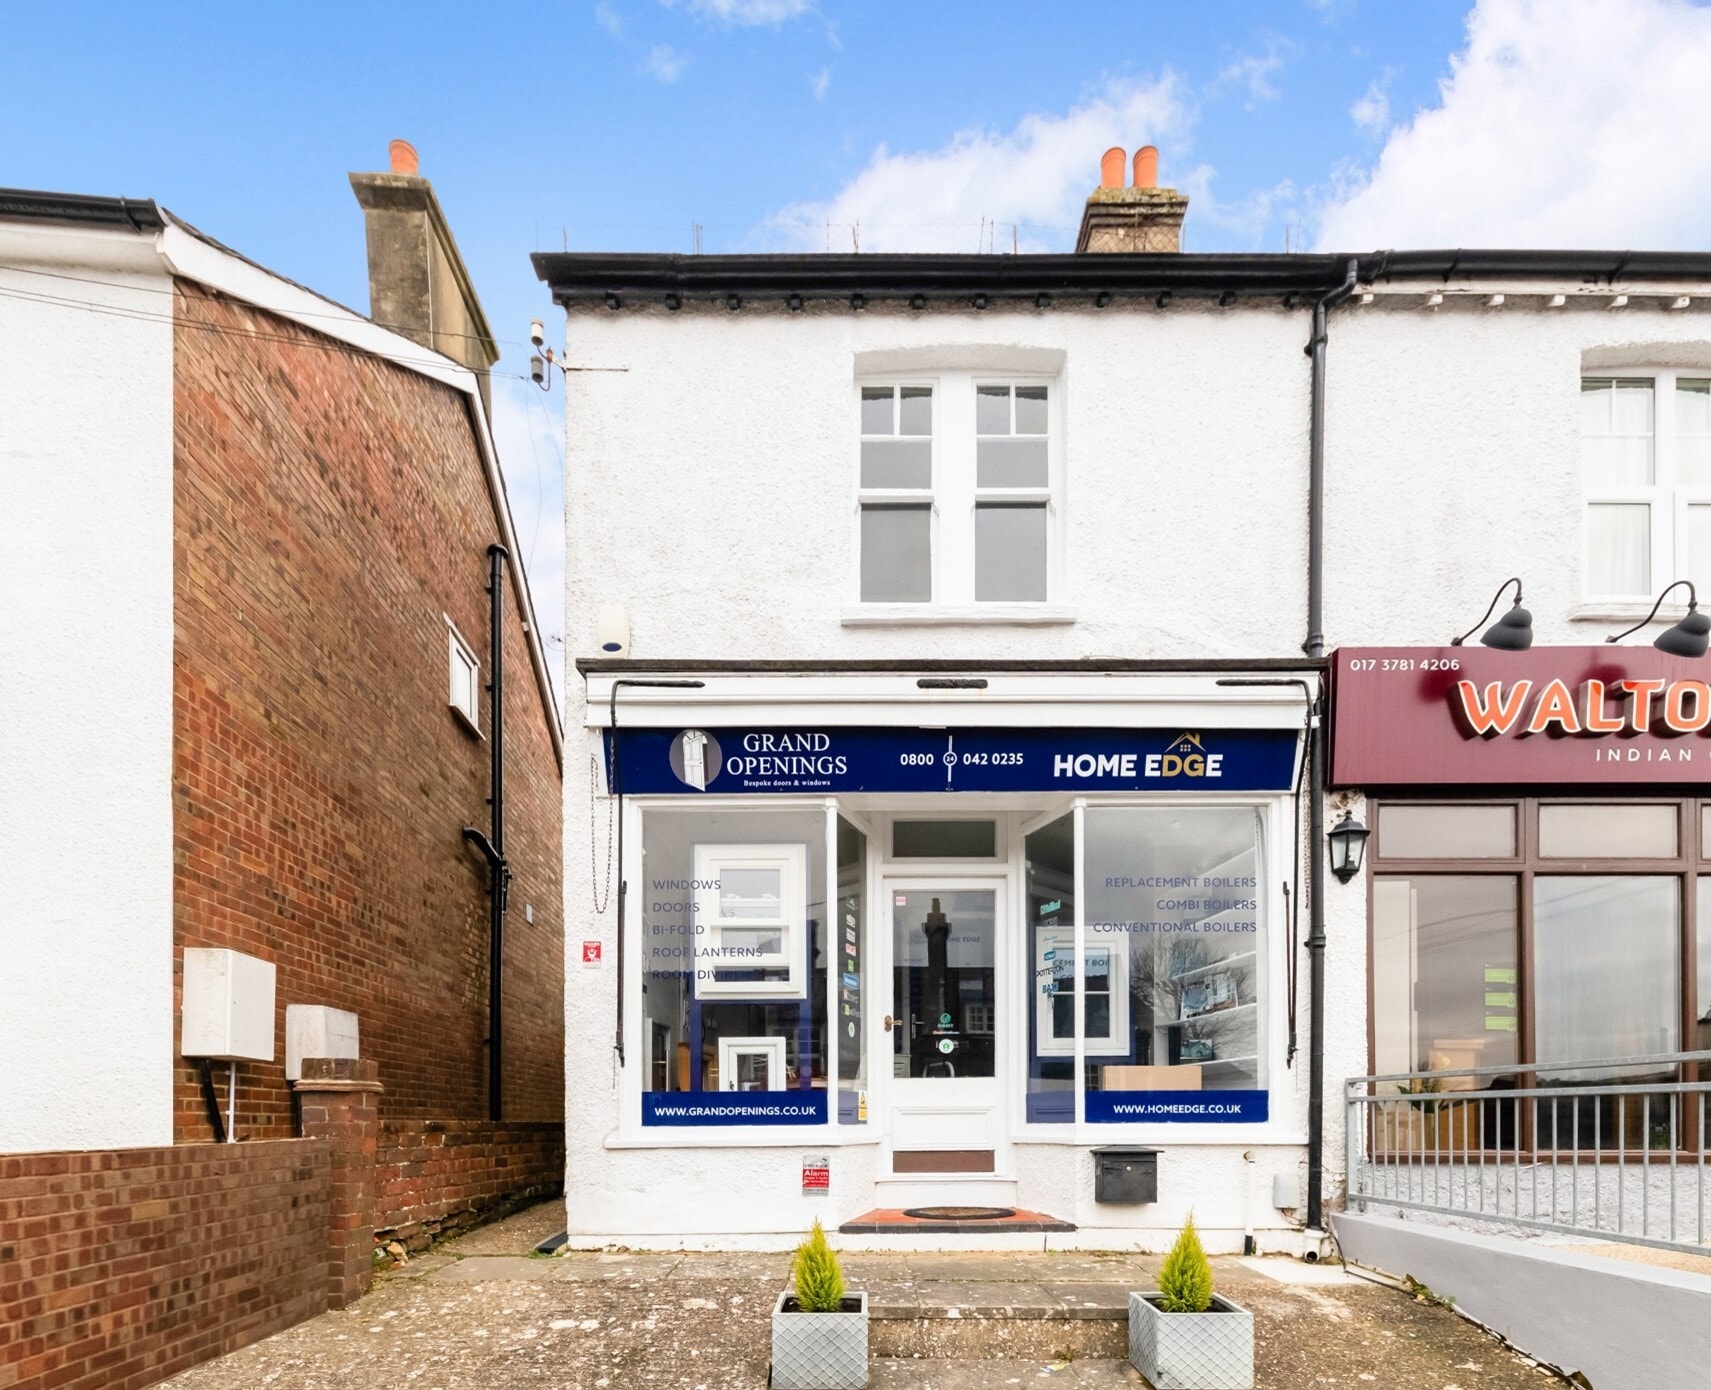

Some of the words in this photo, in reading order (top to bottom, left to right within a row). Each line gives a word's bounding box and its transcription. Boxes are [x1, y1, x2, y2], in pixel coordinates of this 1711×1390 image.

[1350, 659, 1376, 671] 017
[1381, 659, 1415, 671] 3781
[1420, 659, 1460, 671] 4206
[743, 733, 830, 752] GRAND
[900, 754, 934, 766] 0800
[963, 753, 988, 766] 042
[992, 753, 1023, 765] 0235
[1596, 748, 1692, 761] INDIAN
[726, 756, 847, 775] OPENINGS
[1053, 754, 1137, 777] HOME
[1144, 754, 1223, 777] EDGE
[743, 779, 771, 788] Bespoke
[773, 779, 791, 787] doors
[793, 779, 799, 787] &
[801, 779, 831, 787] windows
[653, 880, 721, 890] WINDOWS
[1105, 877, 1199, 888] REPLACEMENT
[1203, 877, 1257, 888] BOILERS
[653, 902, 700, 913] DOORS
[1156, 899, 1200, 910] COMBI
[1203, 899, 1257, 910] BOILERS
[653, 925, 705, 935] BI-FOLD
[1093, 922, 1199, 933] CONVENTIONAL
[1203, 922, 1257, 933] BOILERS
[653, 948, 688, 957] ROOF
[694, 947, 763, 957] LANTERNS
[652, 970, 693, 980] ROOM
[654, 1106, 816, 1116] WWW.GRANDOPENINGS.CO.UK
[1113, 1104, 1242, 1114] WWW.HOMEEDGE.CO.UK
